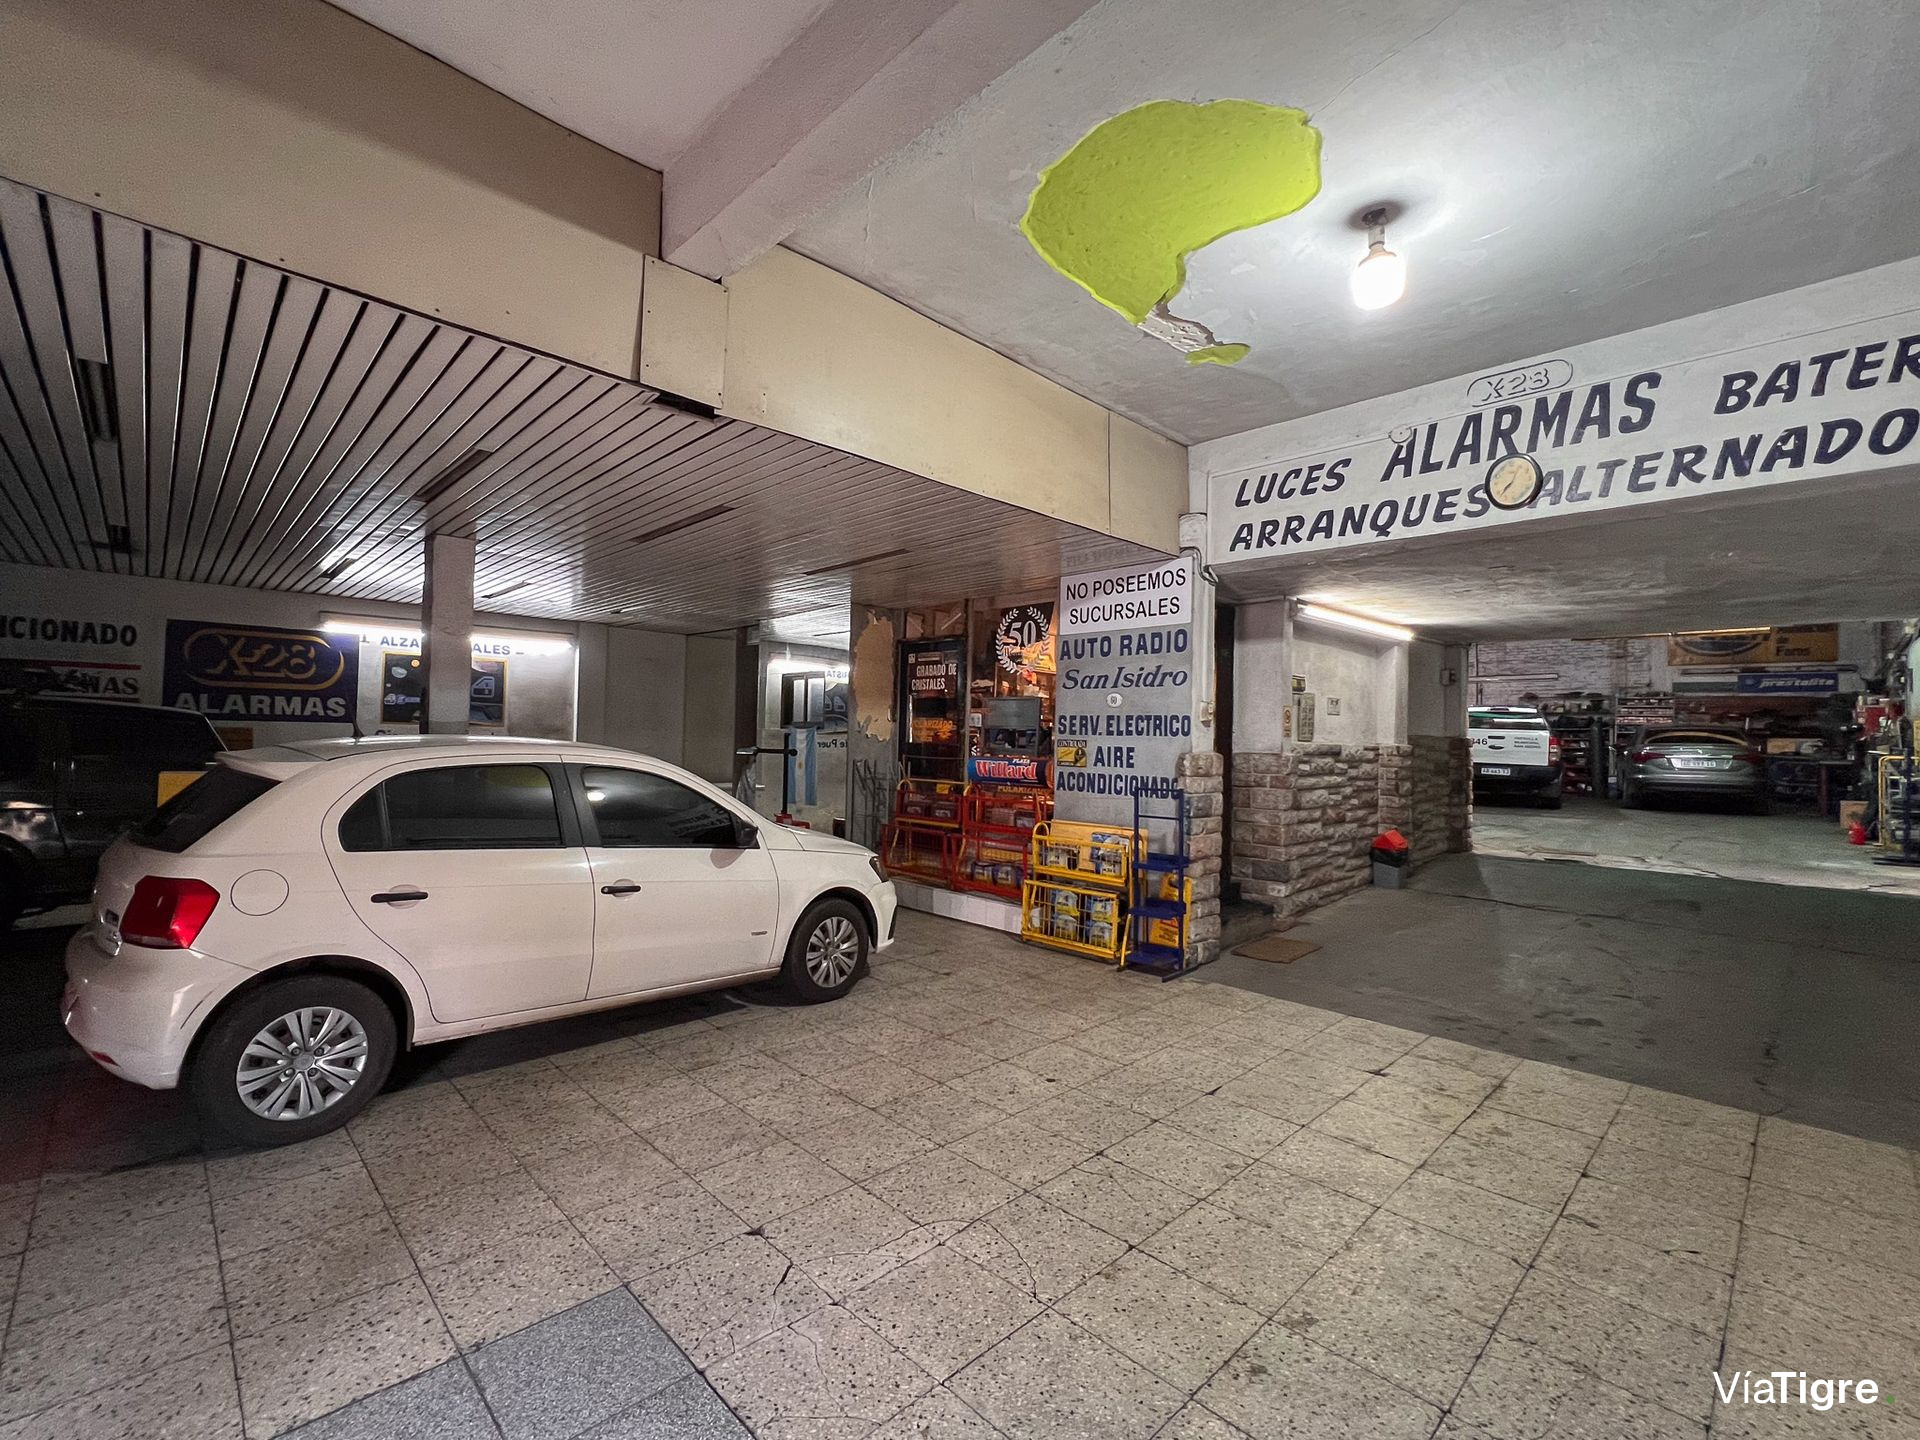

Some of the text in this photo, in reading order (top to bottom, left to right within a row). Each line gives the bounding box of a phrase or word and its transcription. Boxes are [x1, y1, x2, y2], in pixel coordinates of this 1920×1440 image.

[1234, 458, 1352, 508] LUCES
[1380, 372, 1662, 482] ALARMAS
[1229, 407, 1920, 552] ARRANQUES ALTERNADO
[1066, 567, 1187, 601] NO POSEEMOS
[1069, 596, 1181, 625] SUCURSALES
[1008, 620, 1037, 649] 50
[1059, 628, 1188, 661] AUTO RADIO
[916, 662, 958, 678] GRABADO DE
[1061, 664, 1189, 690] San Isidro
[911, 677, 946, 691] CRISTALES
[174, 692, 347, 718] ALARMAS
[1057, 714, 1192, 737] SERV. ELECTRICO
[976, 759, 1038, 779] Willard
[1092, 745, 1136, 769] AIRE
[1056, 770, 1181, 801] ACONDICIONADO
